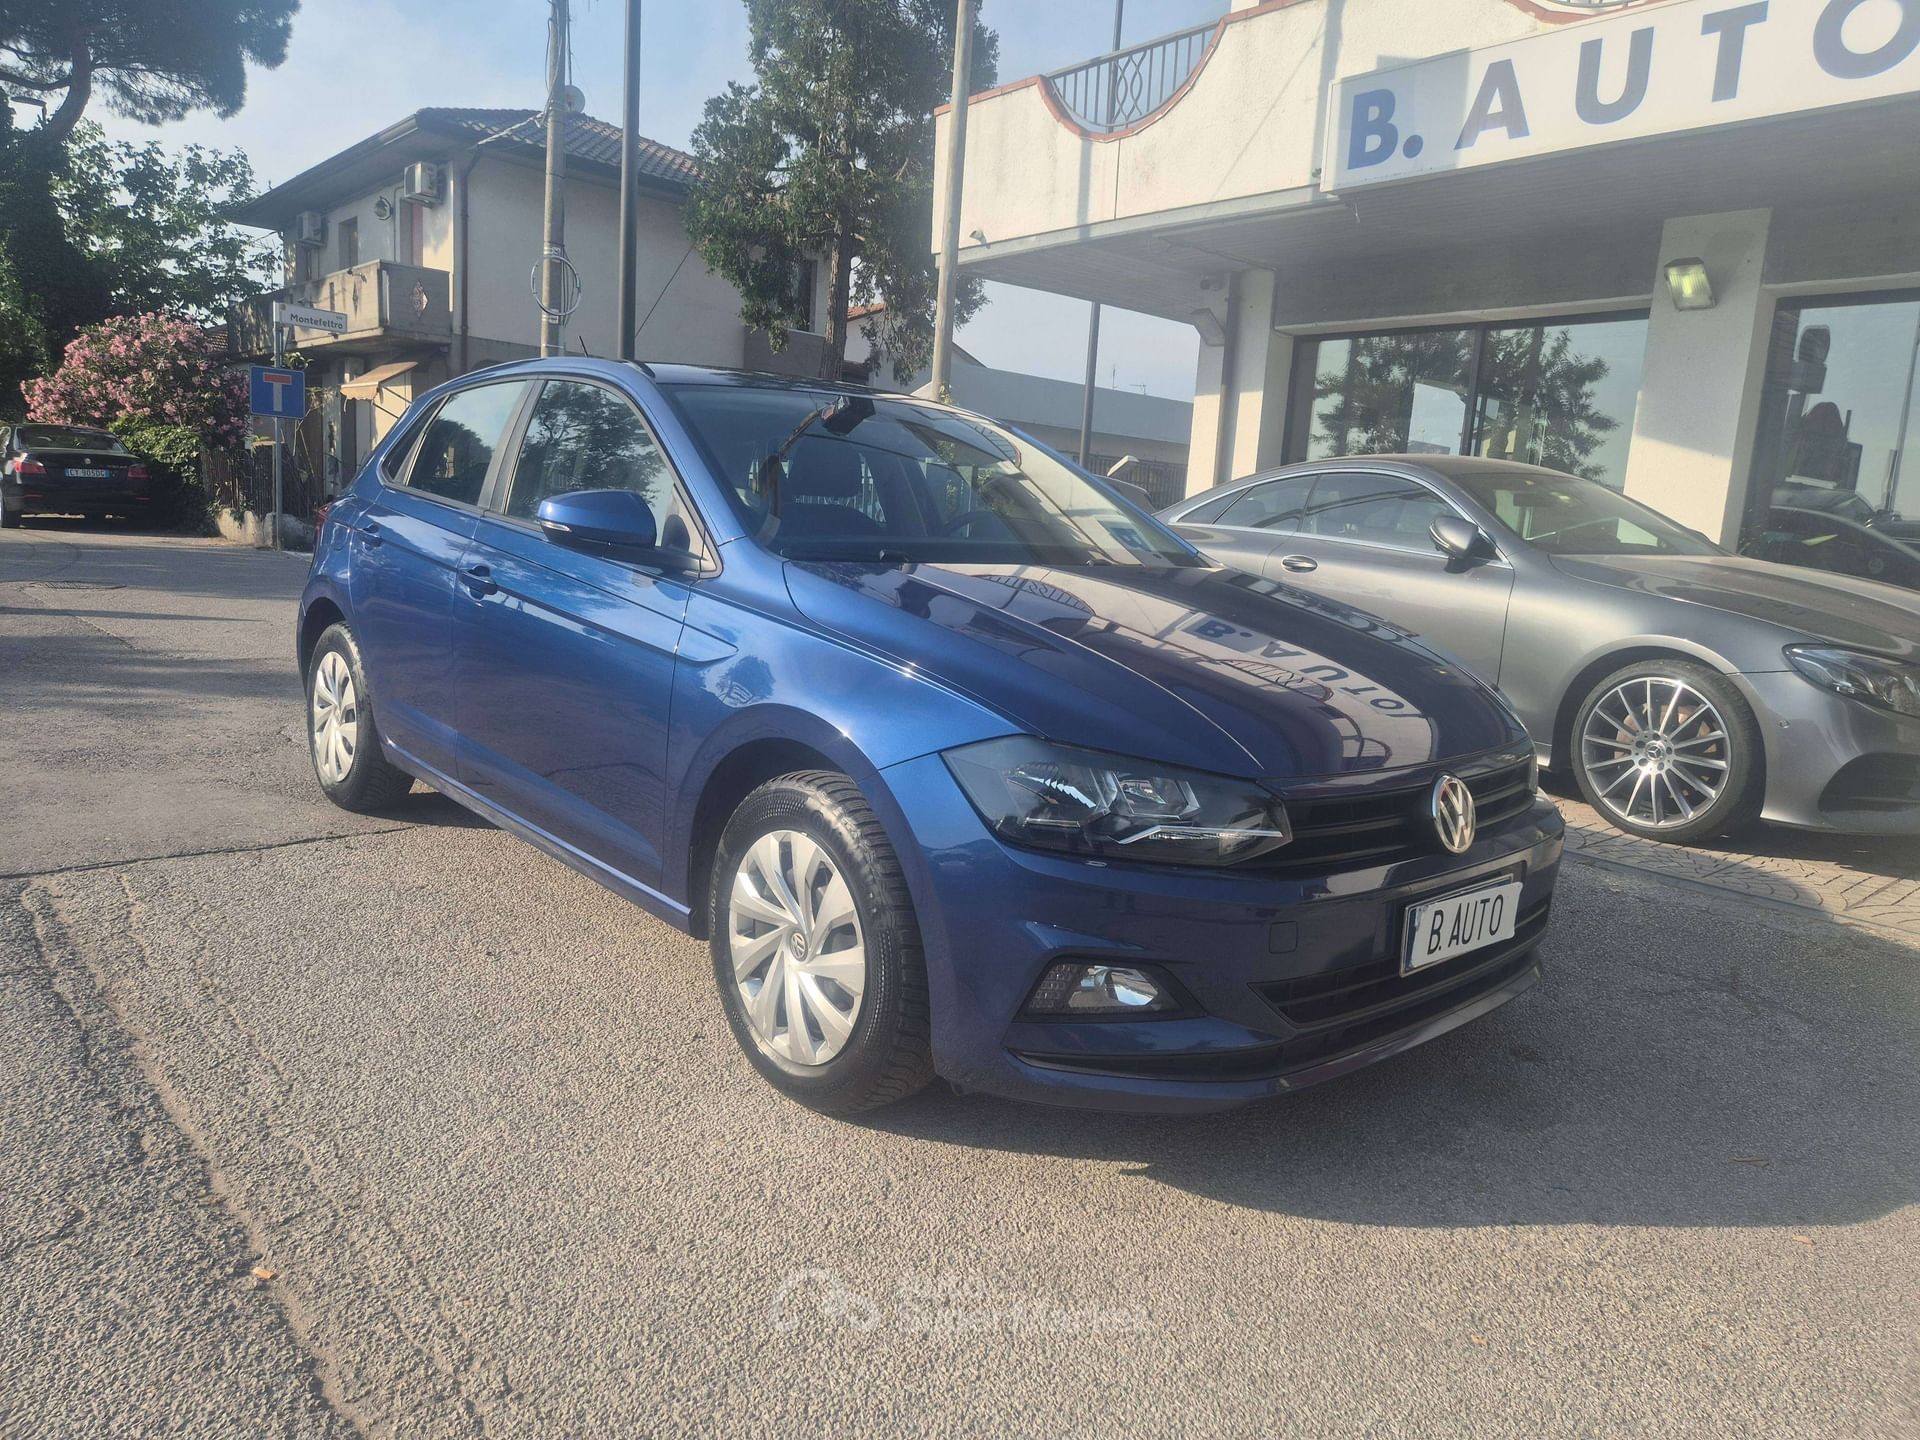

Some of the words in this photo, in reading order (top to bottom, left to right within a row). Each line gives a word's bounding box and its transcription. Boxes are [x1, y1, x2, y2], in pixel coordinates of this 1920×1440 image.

[1347, 88, 1424, 170] B.
[1453, 0, 1920, 151] AUTO
[290, 313, 343, 329] Montefeltro
[1448, 894, 1505, 948] AUTO
